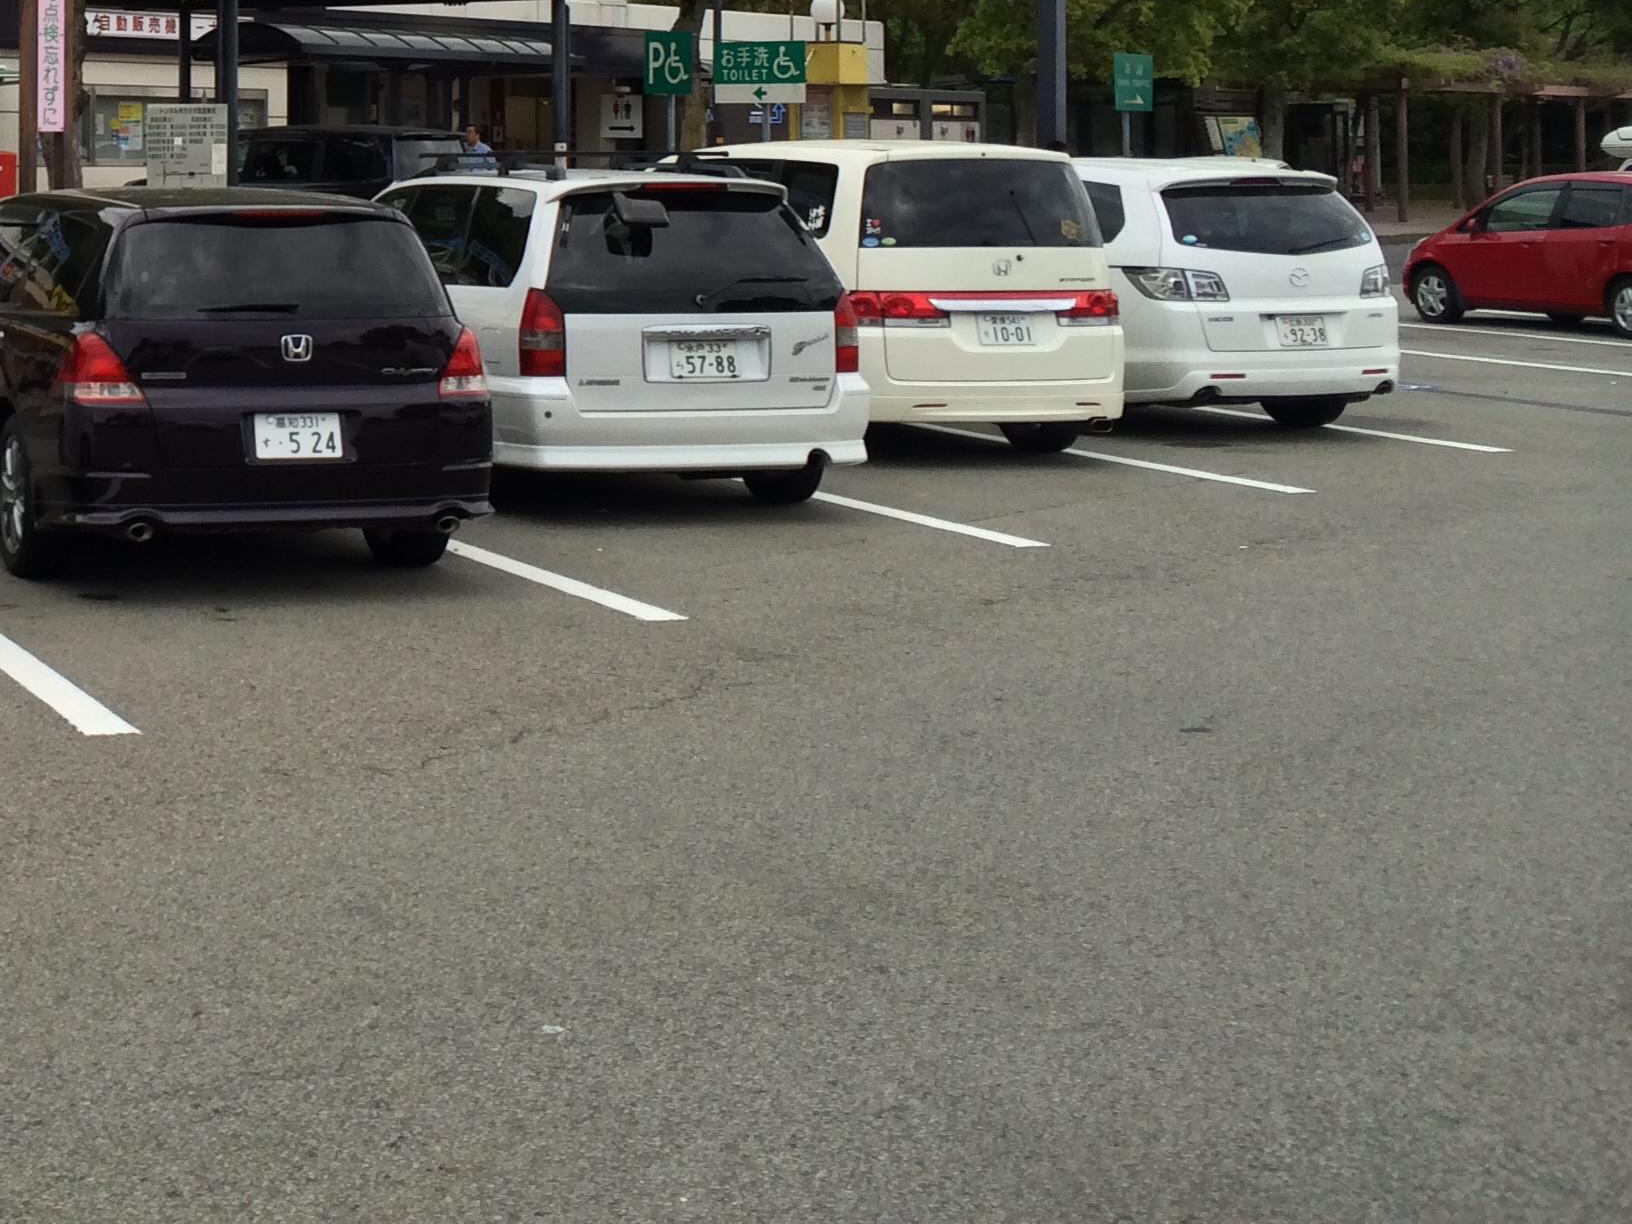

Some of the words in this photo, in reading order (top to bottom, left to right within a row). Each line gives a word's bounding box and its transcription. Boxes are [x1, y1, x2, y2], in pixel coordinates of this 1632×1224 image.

[648, 41, 666, 85] P
[721, 46, 770, 68] お手洗
[722, 69, 768, 81] TOILET
[992, 326, 1033, 342] 10-01
[1290, 327, 1328, 343] 92-38
[685, 355, 737, 374] 57-88
